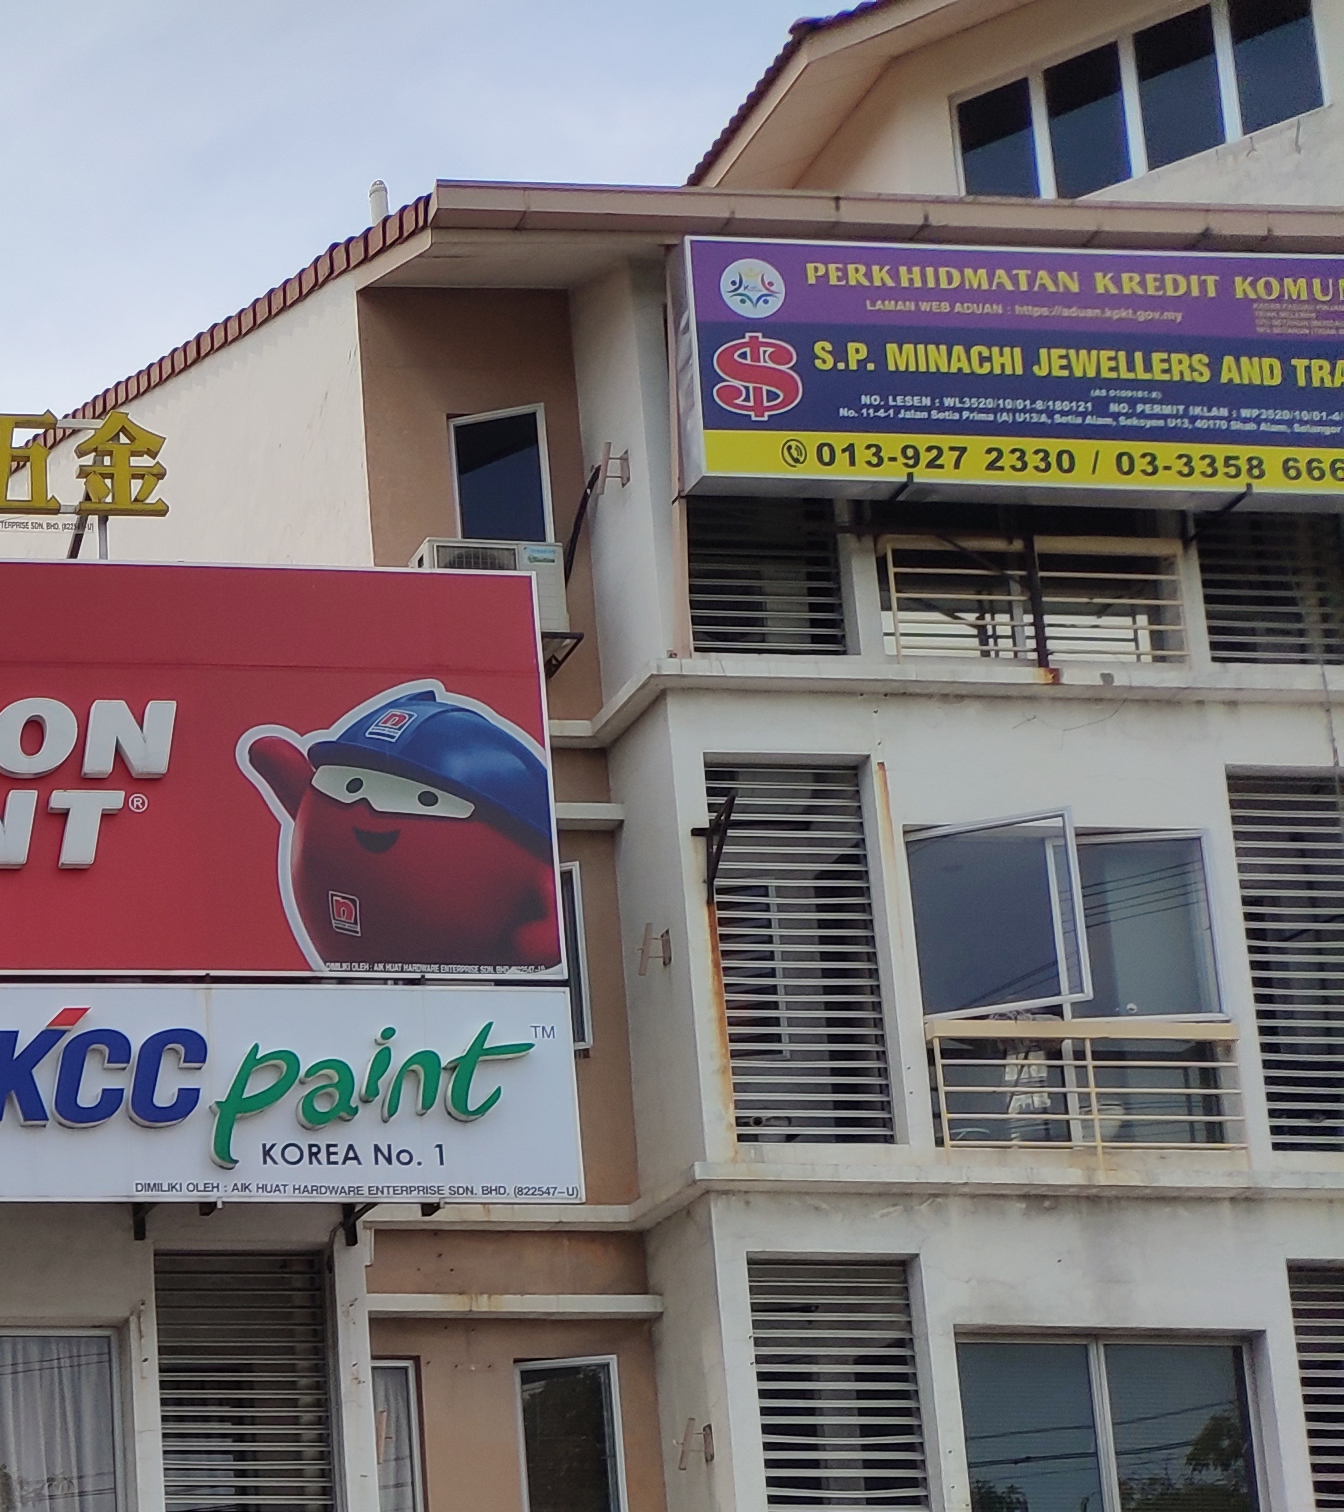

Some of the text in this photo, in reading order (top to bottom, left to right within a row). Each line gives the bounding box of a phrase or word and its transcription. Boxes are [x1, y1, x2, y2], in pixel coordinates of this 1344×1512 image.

[806, 263, 1344, 301] PERKHIDMATAN KREDIT KOMU
[866, 300, 1003, 315] LAMAN WEB ADUAN
[814, 340, 875, 372] S.P.
[886, 343, 1023, 376] MINACHI
[1033, 349, 1211, 384] JEWELLERS
[1220, 357, 1282, 386] AND
[861, 395, 930, 407] NO. LESEN
[1137, 404, 1185, 416] PERMIT
[815, 439, 969, 471] 013-927
[984, 445, 1077, 475] 2330
[1115, 451, 1266, 481] 03-3358
[210, 1021, 536, 1170] paint
[261, 1142, 446, 1167] KOREA No. 1
[135, 1181, 184, 1194] DIMILIKI
[187, 1182, 221, 1194] OLEH
[230, 1182, 252, 1195] AIK
[255, 1182, 290, 1195] HUAT
[293, 1183, 365, 1196] HARDWARE
[368, 1184, 446, 1197] ENTERPRISE
[448, 1185, 479, 1198] SDN.
[482, 1186, 510, 1198] BHD.
